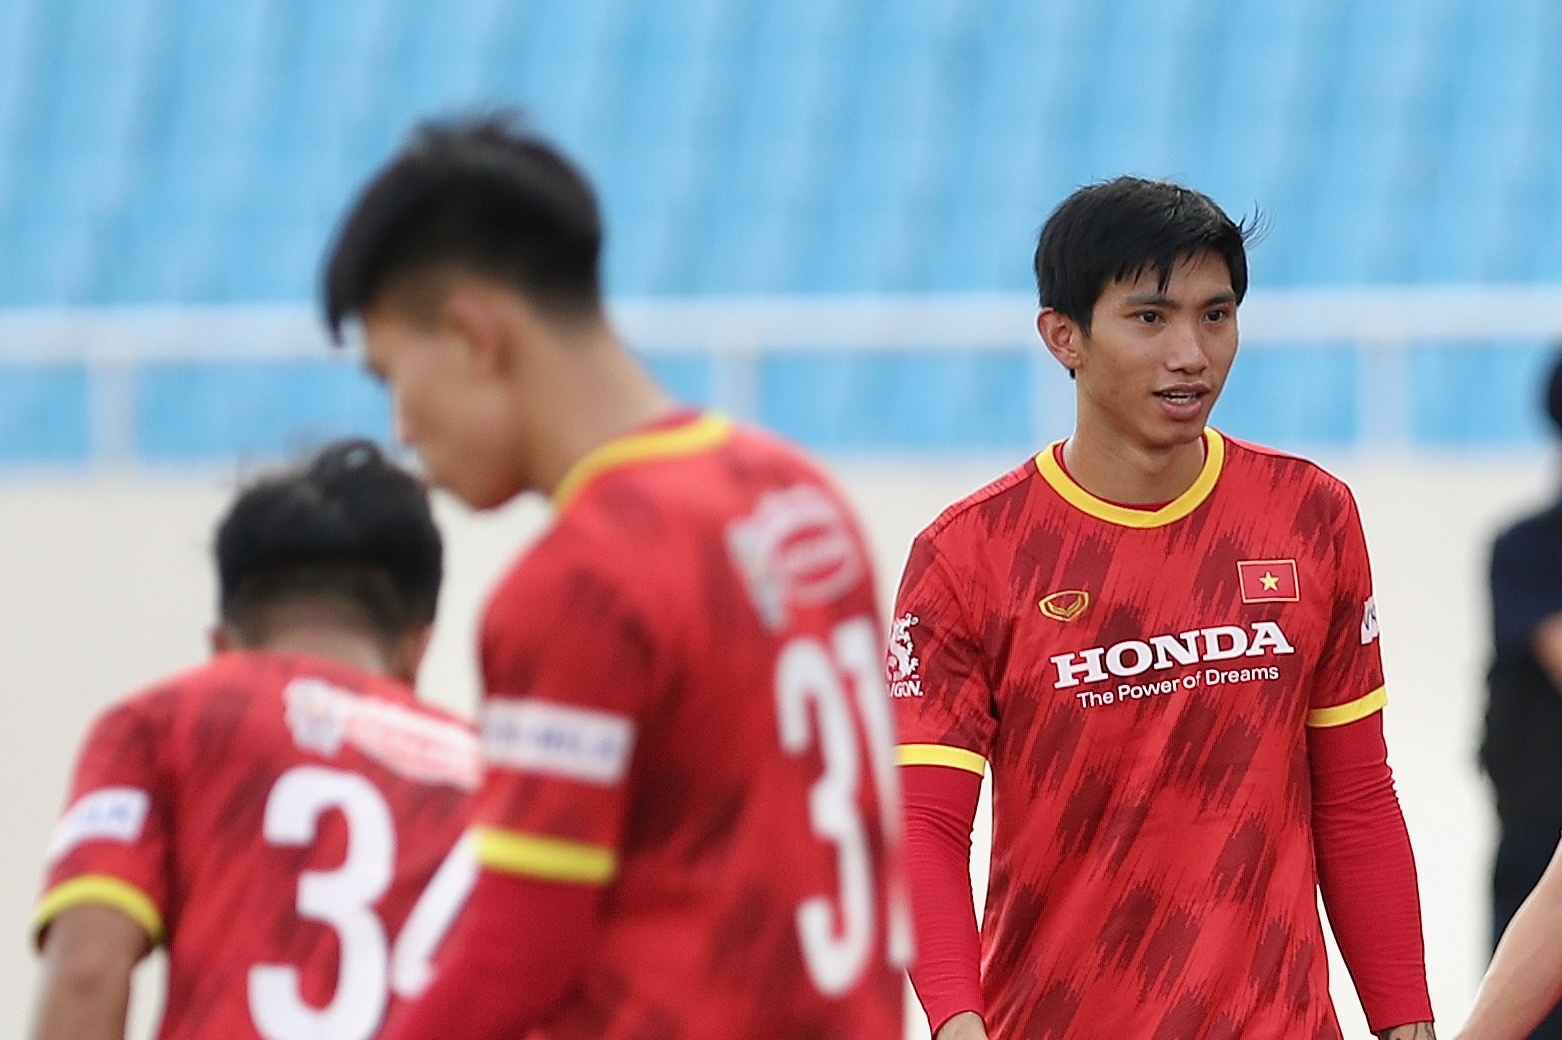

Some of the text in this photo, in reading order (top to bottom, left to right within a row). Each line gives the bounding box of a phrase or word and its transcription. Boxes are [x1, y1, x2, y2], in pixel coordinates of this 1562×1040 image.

[1051, 622, 1294, 688] HONDA
[889, 681, 923, 697] IGON.
[1077, 665, 1279, 708] The Power of Dreams
